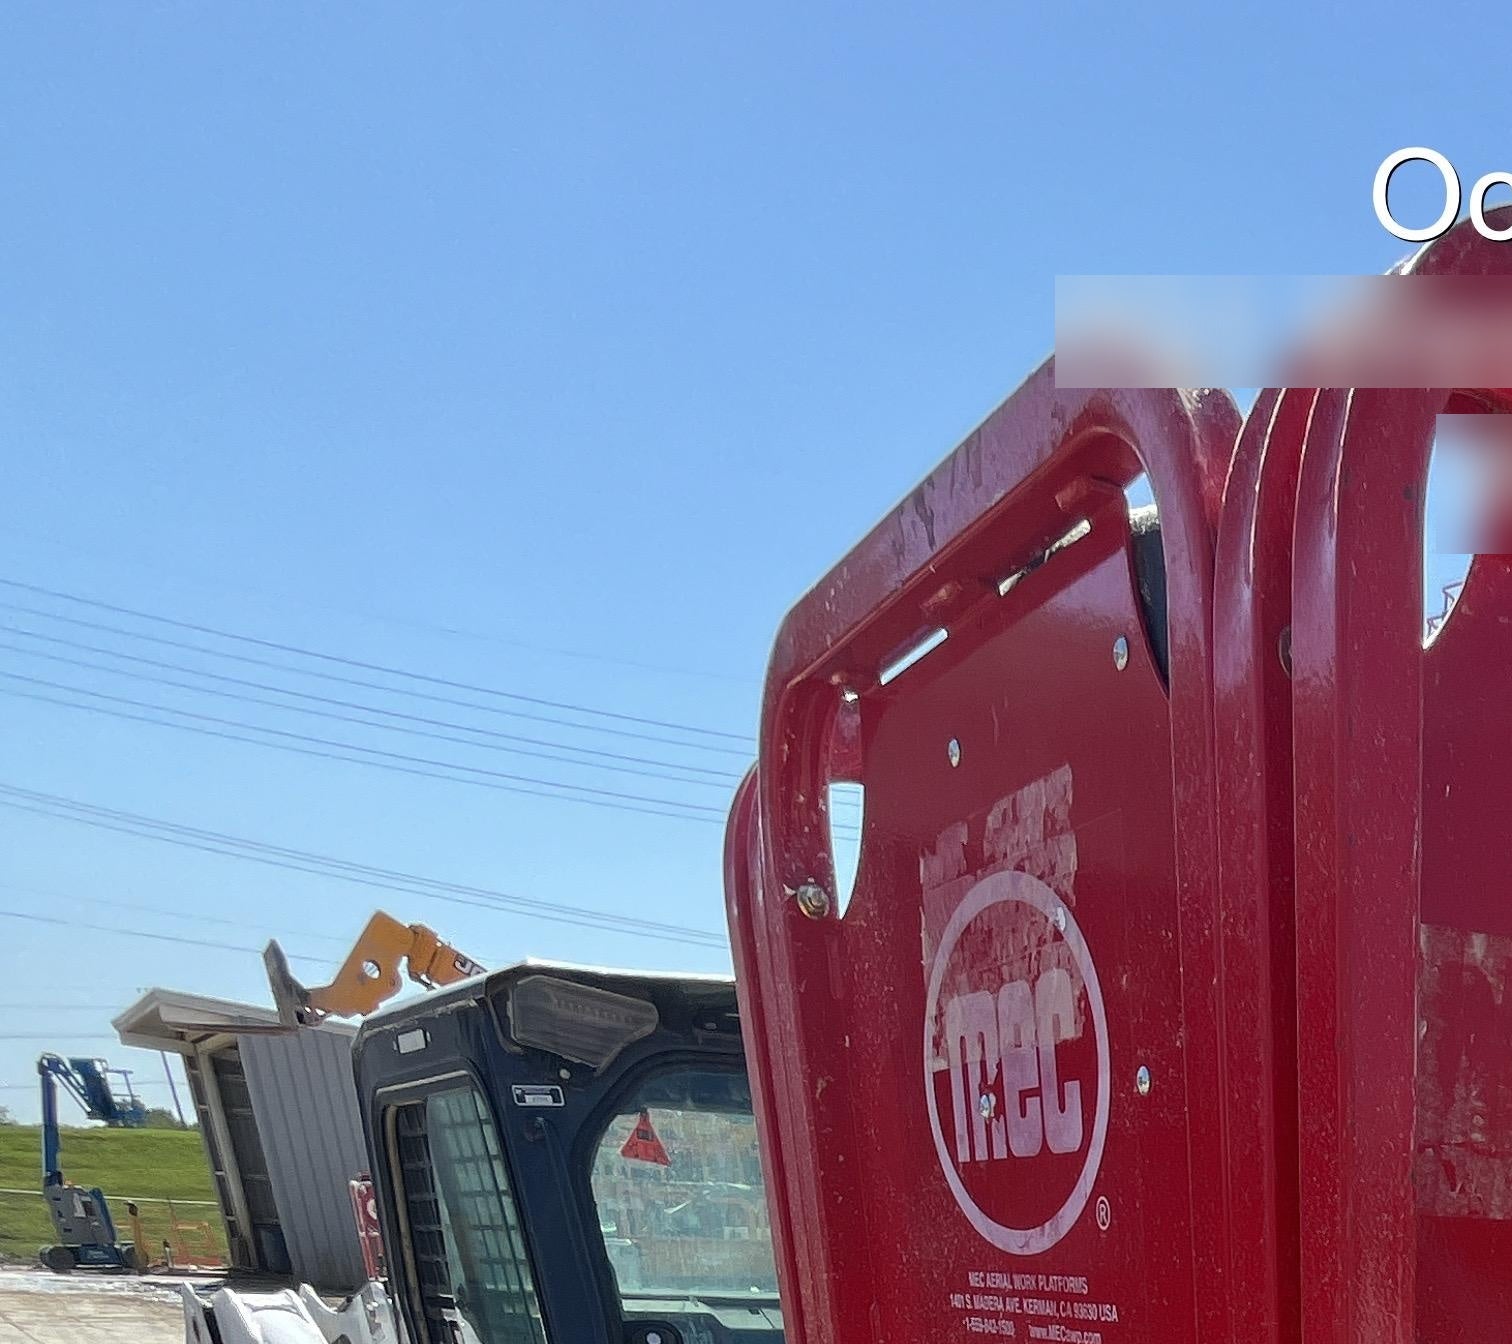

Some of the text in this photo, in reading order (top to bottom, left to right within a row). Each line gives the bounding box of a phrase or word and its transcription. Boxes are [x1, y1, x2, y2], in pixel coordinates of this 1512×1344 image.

[968, 1271, 1089, 1295] MEC AERIAL WORK PLATFORMS
[1060, 1301, 1072, 1318] CA
[1098, 1304, 1119, 1322] USA
